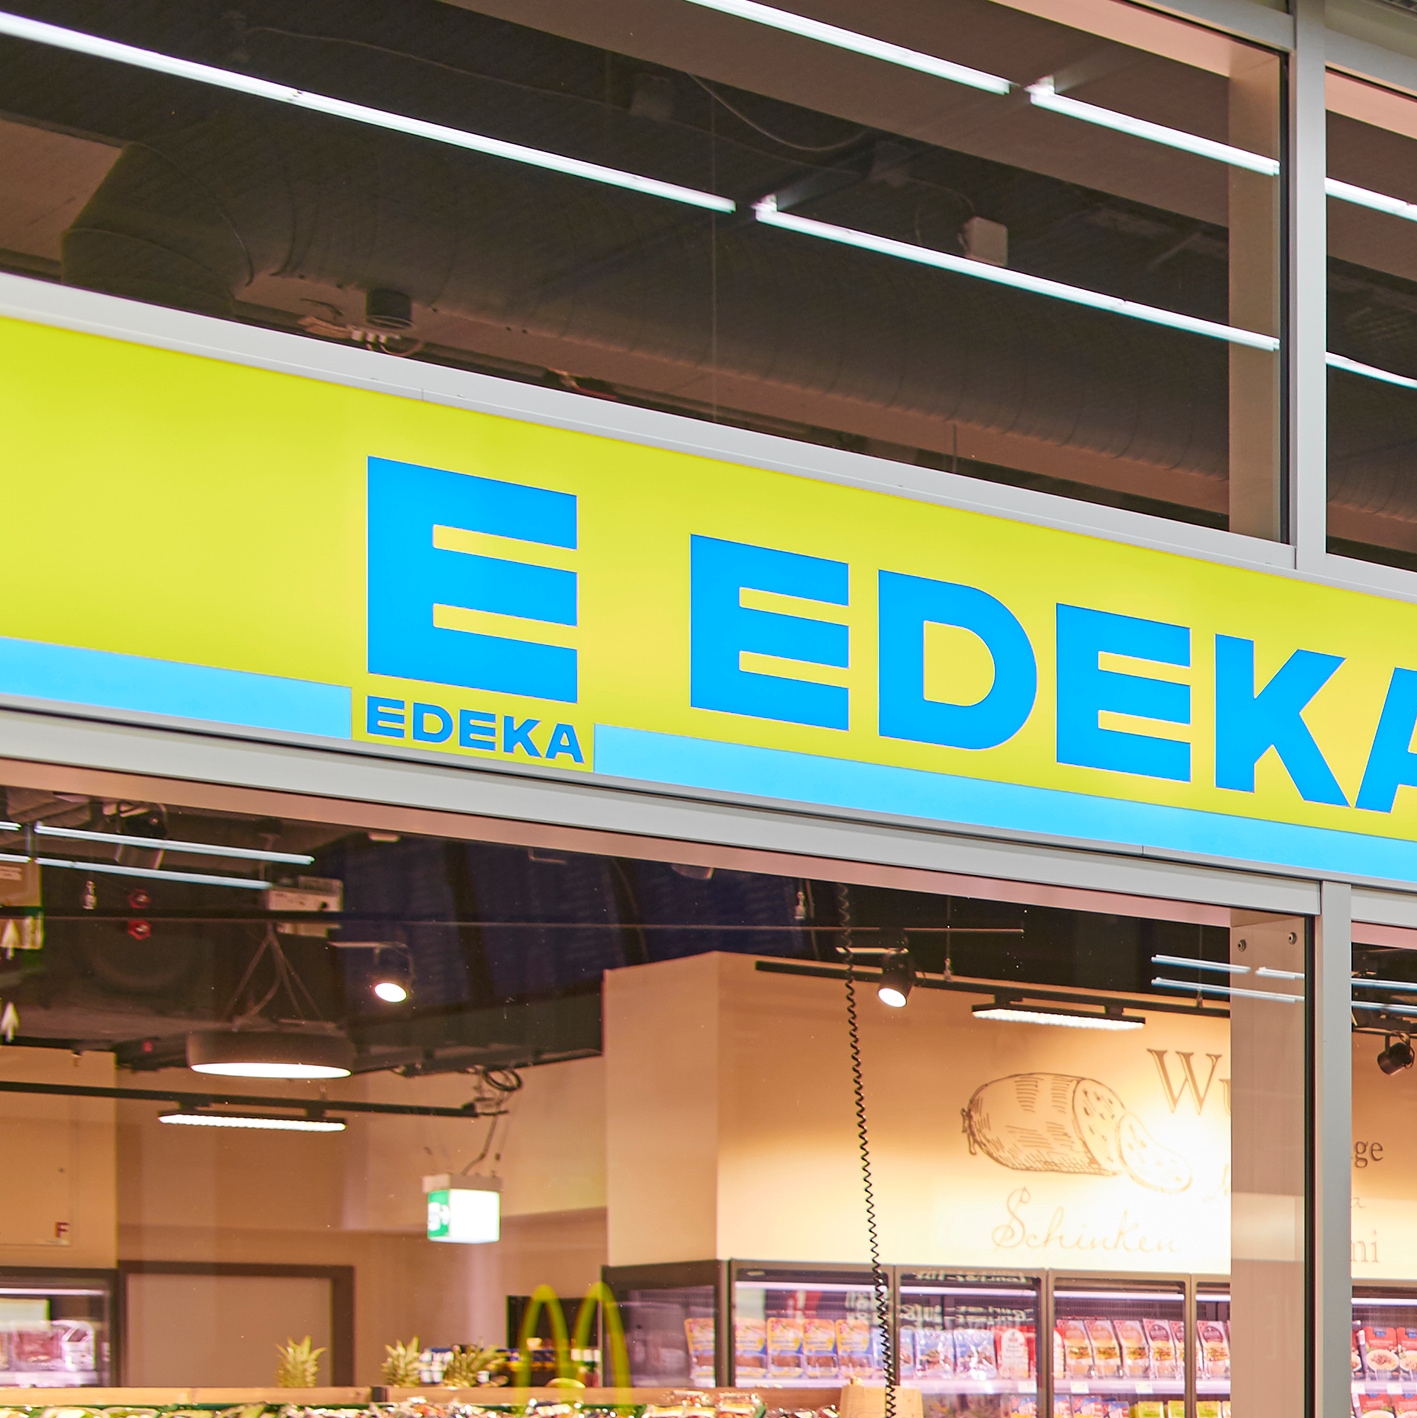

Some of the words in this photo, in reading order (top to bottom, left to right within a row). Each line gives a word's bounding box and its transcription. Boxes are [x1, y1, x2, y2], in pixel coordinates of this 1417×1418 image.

[367, 455, 578, 704] E
[365, 694, 586, 765] EDEKA
[991, 1186, 1181, 1254] Schinken
